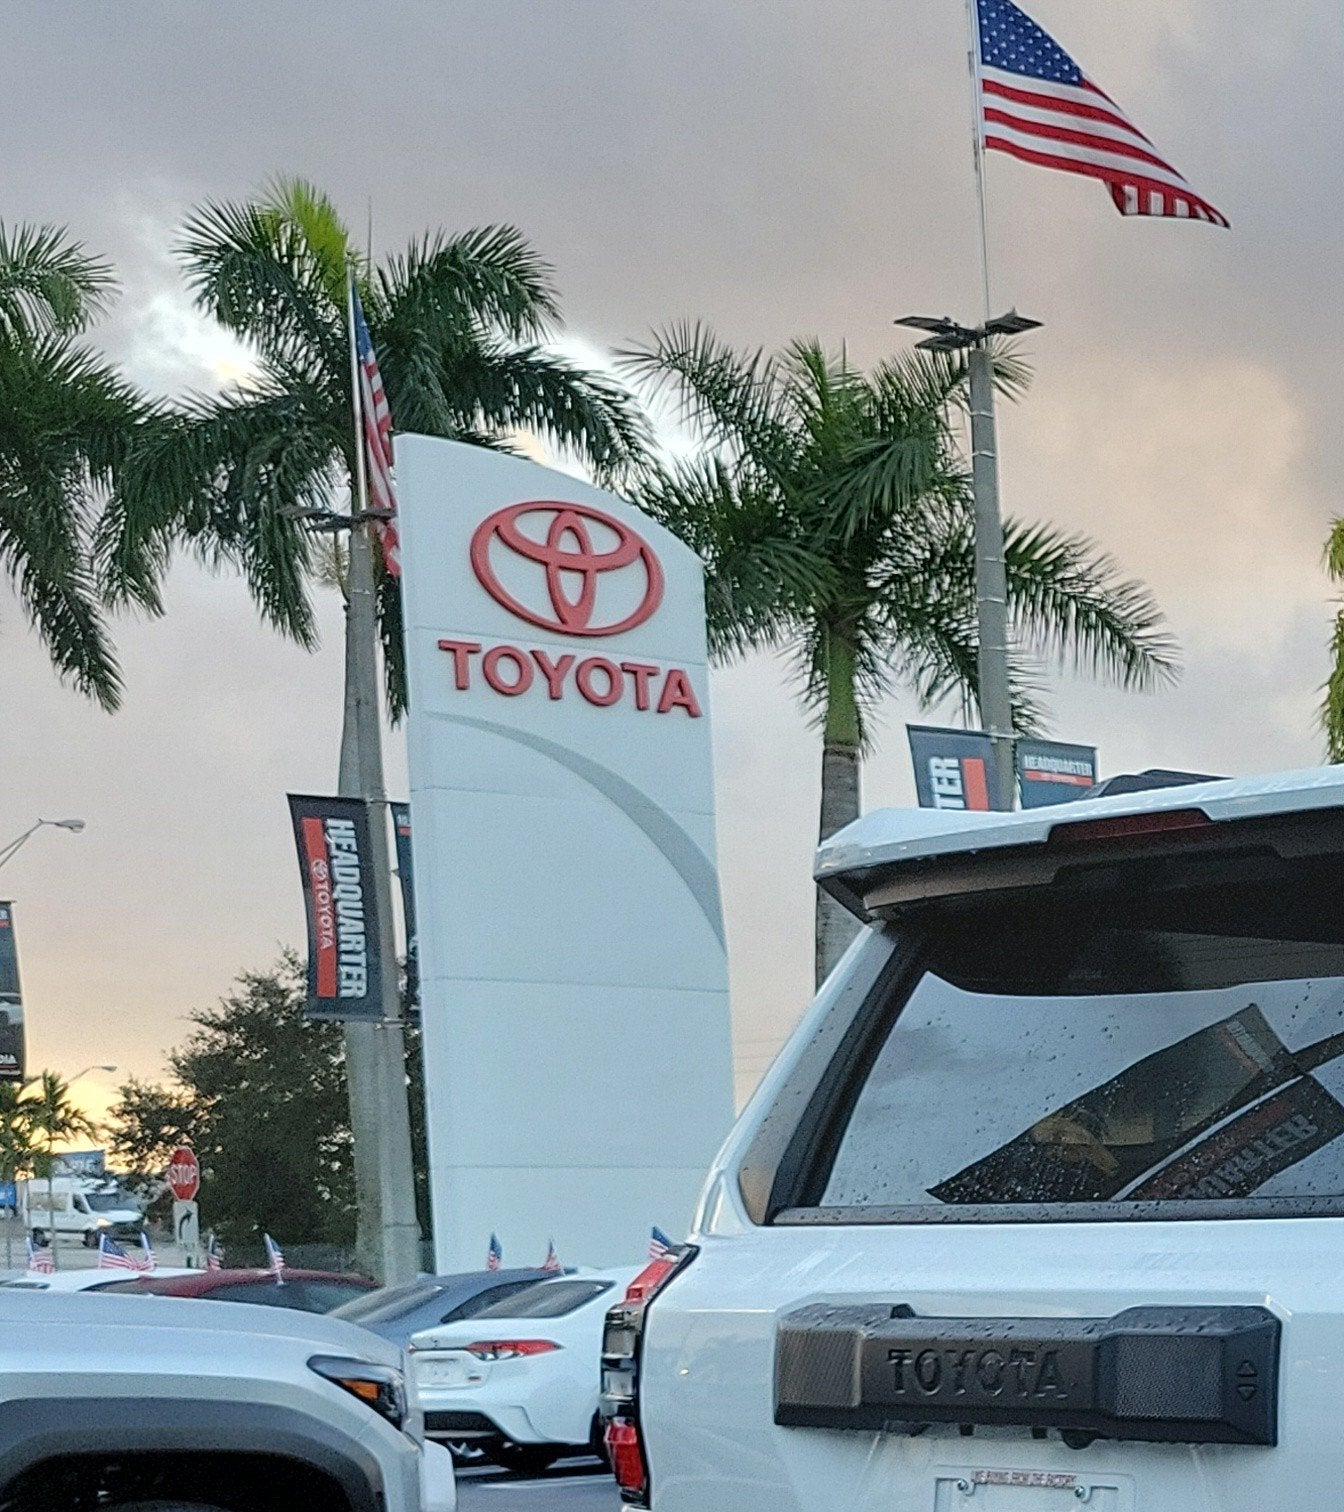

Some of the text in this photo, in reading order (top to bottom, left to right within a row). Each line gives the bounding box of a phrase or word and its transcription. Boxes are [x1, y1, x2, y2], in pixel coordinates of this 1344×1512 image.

[438, 639, 702, 717] TOYOTA
[314, 881, 334, 950] TOYOTA
[326, 818, 367, 998] HEADQUARTER
[170, 1163, 198, 1184] STOP
[887, 1348, 1069, 1399] TOYOTA
